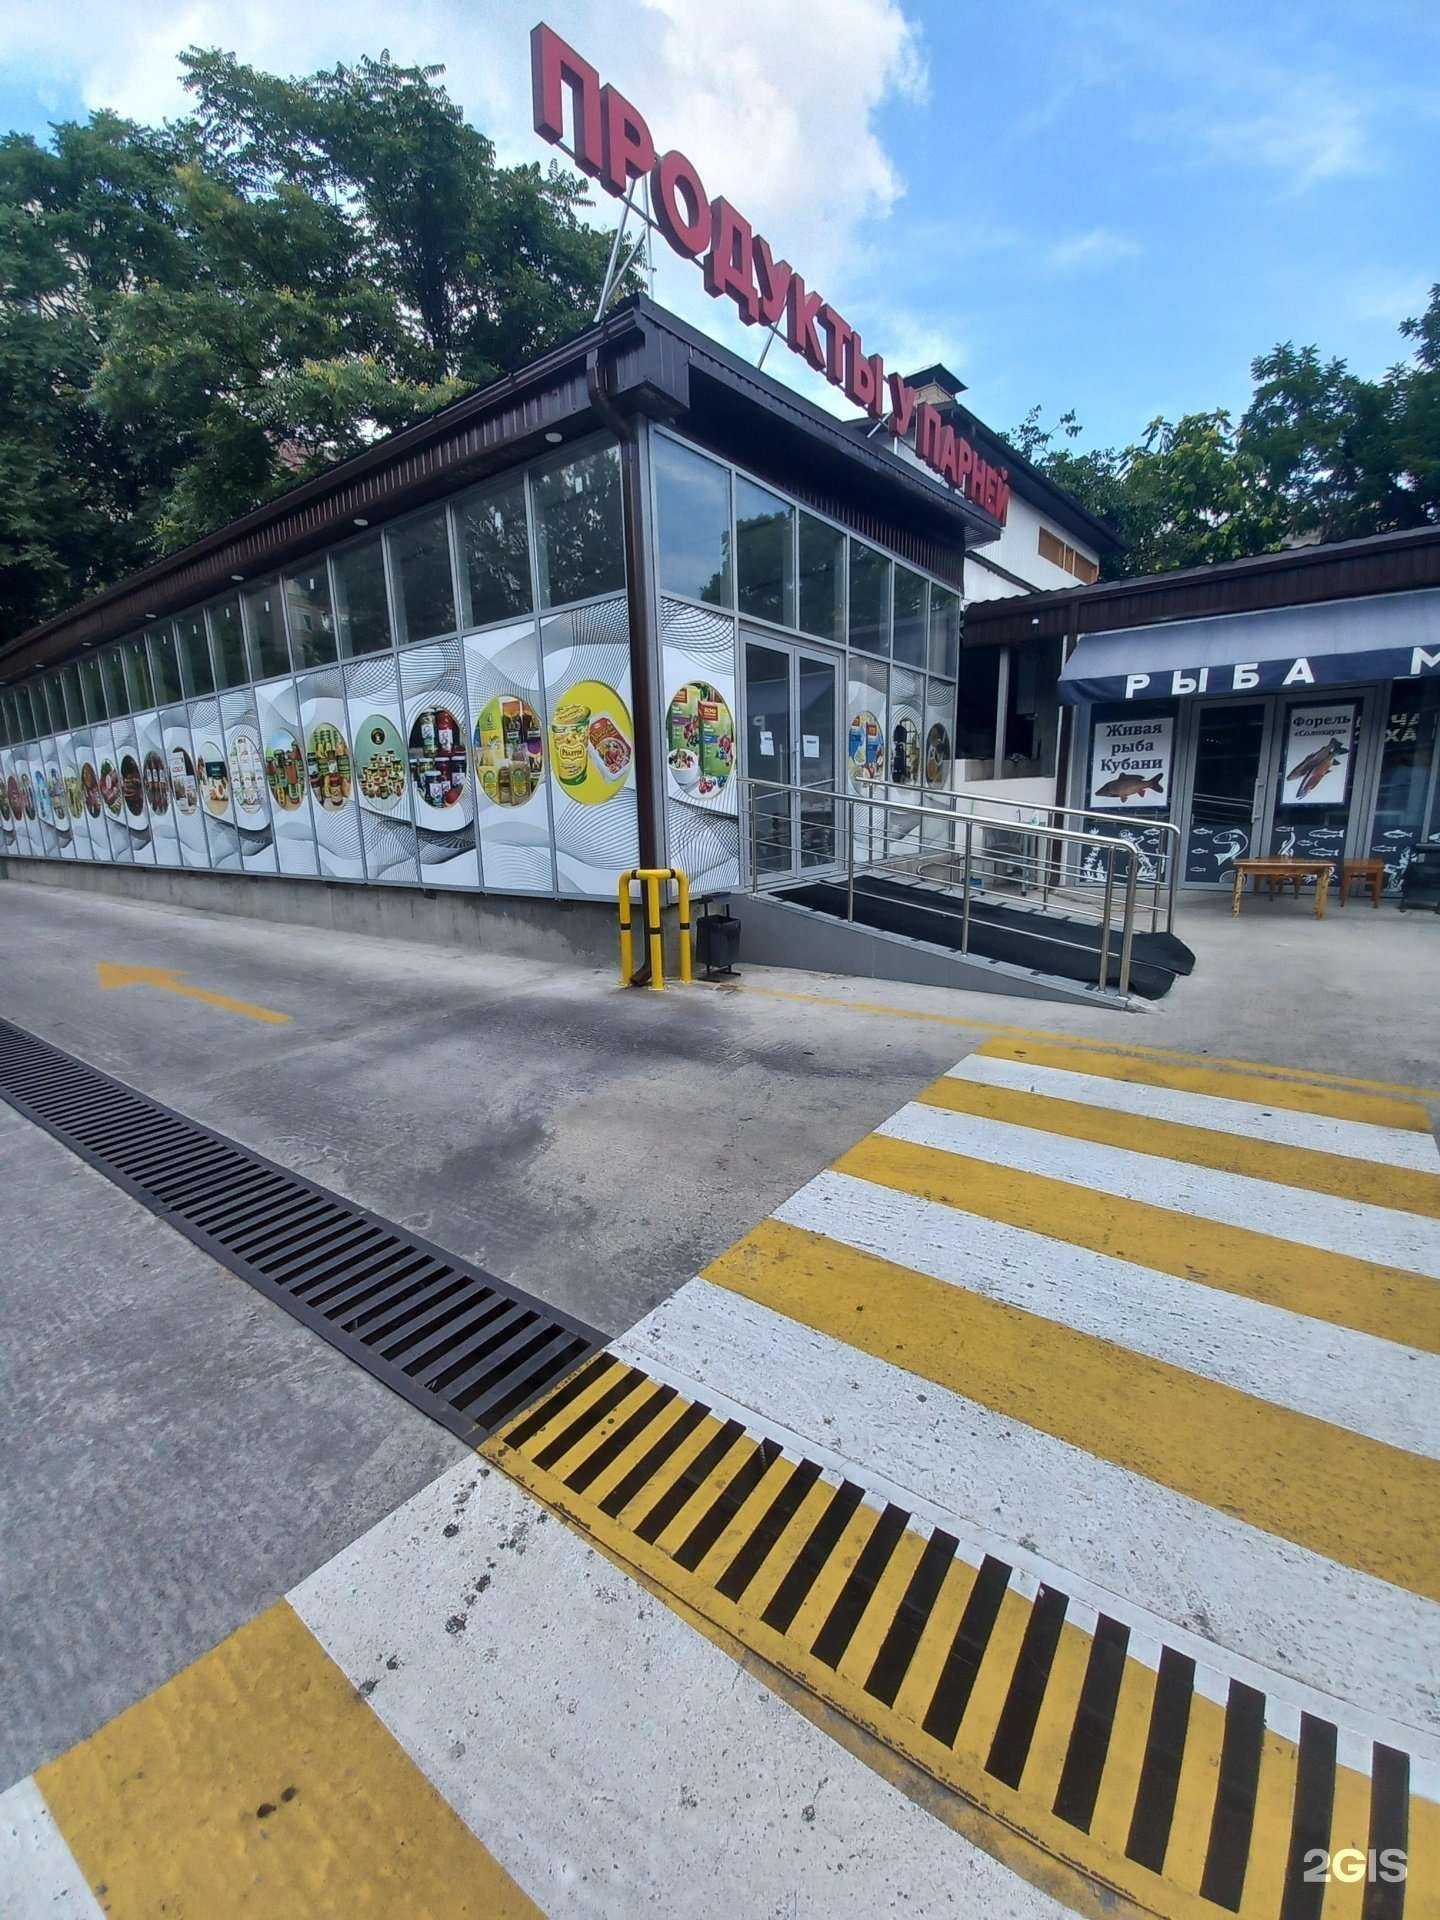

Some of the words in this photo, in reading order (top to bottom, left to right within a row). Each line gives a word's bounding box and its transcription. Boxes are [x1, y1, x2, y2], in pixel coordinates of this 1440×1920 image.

[530, 21, 884, 419] ПРОДУКТЫ
[888, 372, 917, 437] У
[914, 401, 1011, 528] ПАРНЕЙ
[1125, 658, 1316, 699] РЫБА
[1293, 715, 1351, 728] Форель
[1106, 723, 1162, 737] Живая
[1111, 739, 1154, 756] рыба
[1101, 758, 1163, 773] Кубани
